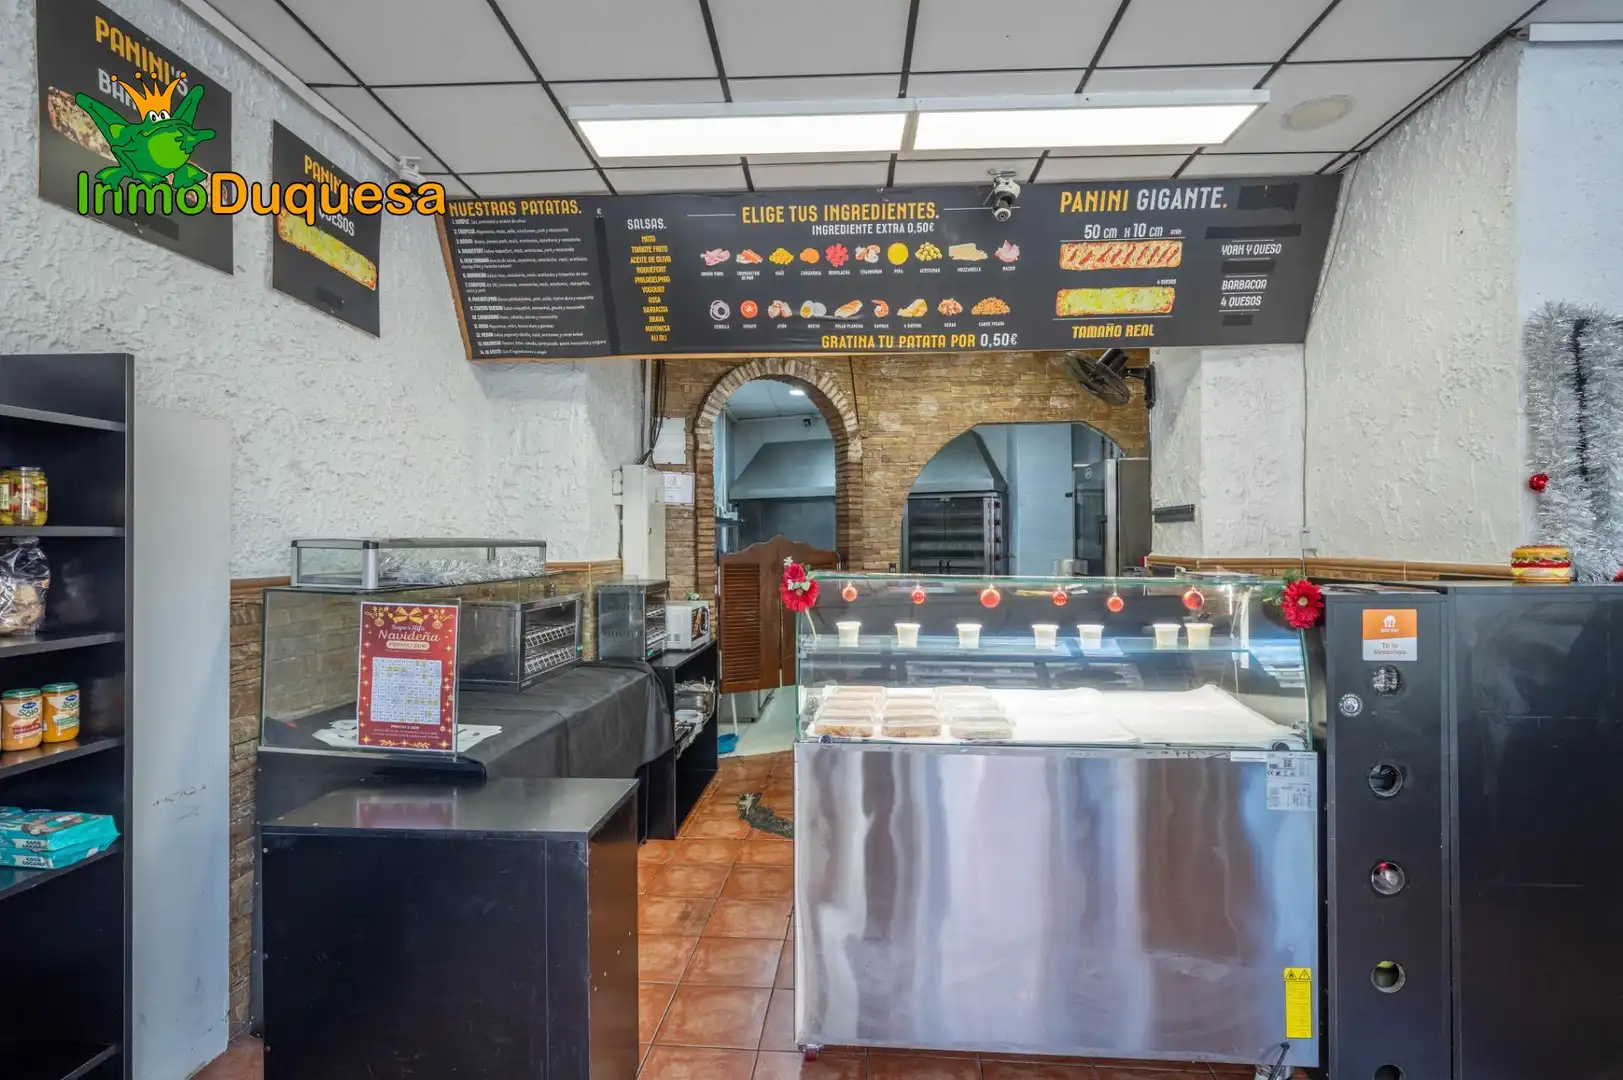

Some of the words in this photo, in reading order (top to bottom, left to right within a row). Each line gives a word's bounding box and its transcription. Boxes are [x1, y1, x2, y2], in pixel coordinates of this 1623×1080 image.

[1060, 190, 1129, 213] PANINI
[1136, 187, 1228, 211] GIGANTE.
[448, 201, 517, 217] NUESTRAS
[521, 200, 582, 216] PATATAS.
[742, 206, 785, 223] ELIGE
[789, 205, 818, 222] TUS
[824, 202, 940, 222] INGREDIENTES.
[627, 219, 667, 229] SALSAS.
[812, 224, 873, 236] INGREDIENTE
[876, 223, 905, 234] EXTRA
[1084, 224, 1101, 239] 50
[1132, 223, 1147, 238] 10
[1221, 245, 1245, 256] YORK
[1245, 244, 1252, 255] Y
[1253, 243, 1282, 255] QUESO
[1221, 279, 1268, 291] BARBACOA
[1220, 298, 1227, 307] 4
[1228, 296, 1262, 308] QUESOS
[1071, 323, 1122, 339] TAMAÑO
[1125, 324, 1155, 337] REAL
[821, 335, 875, 349] GRATINA
[878, 335, 894, 348] TU
[898, 335, 946, 348] PATATA
[951, 334, 976, 348] POR
[980, 333, 1018, 347] 0,50€
[378, 629, 440, 642] Navideña
